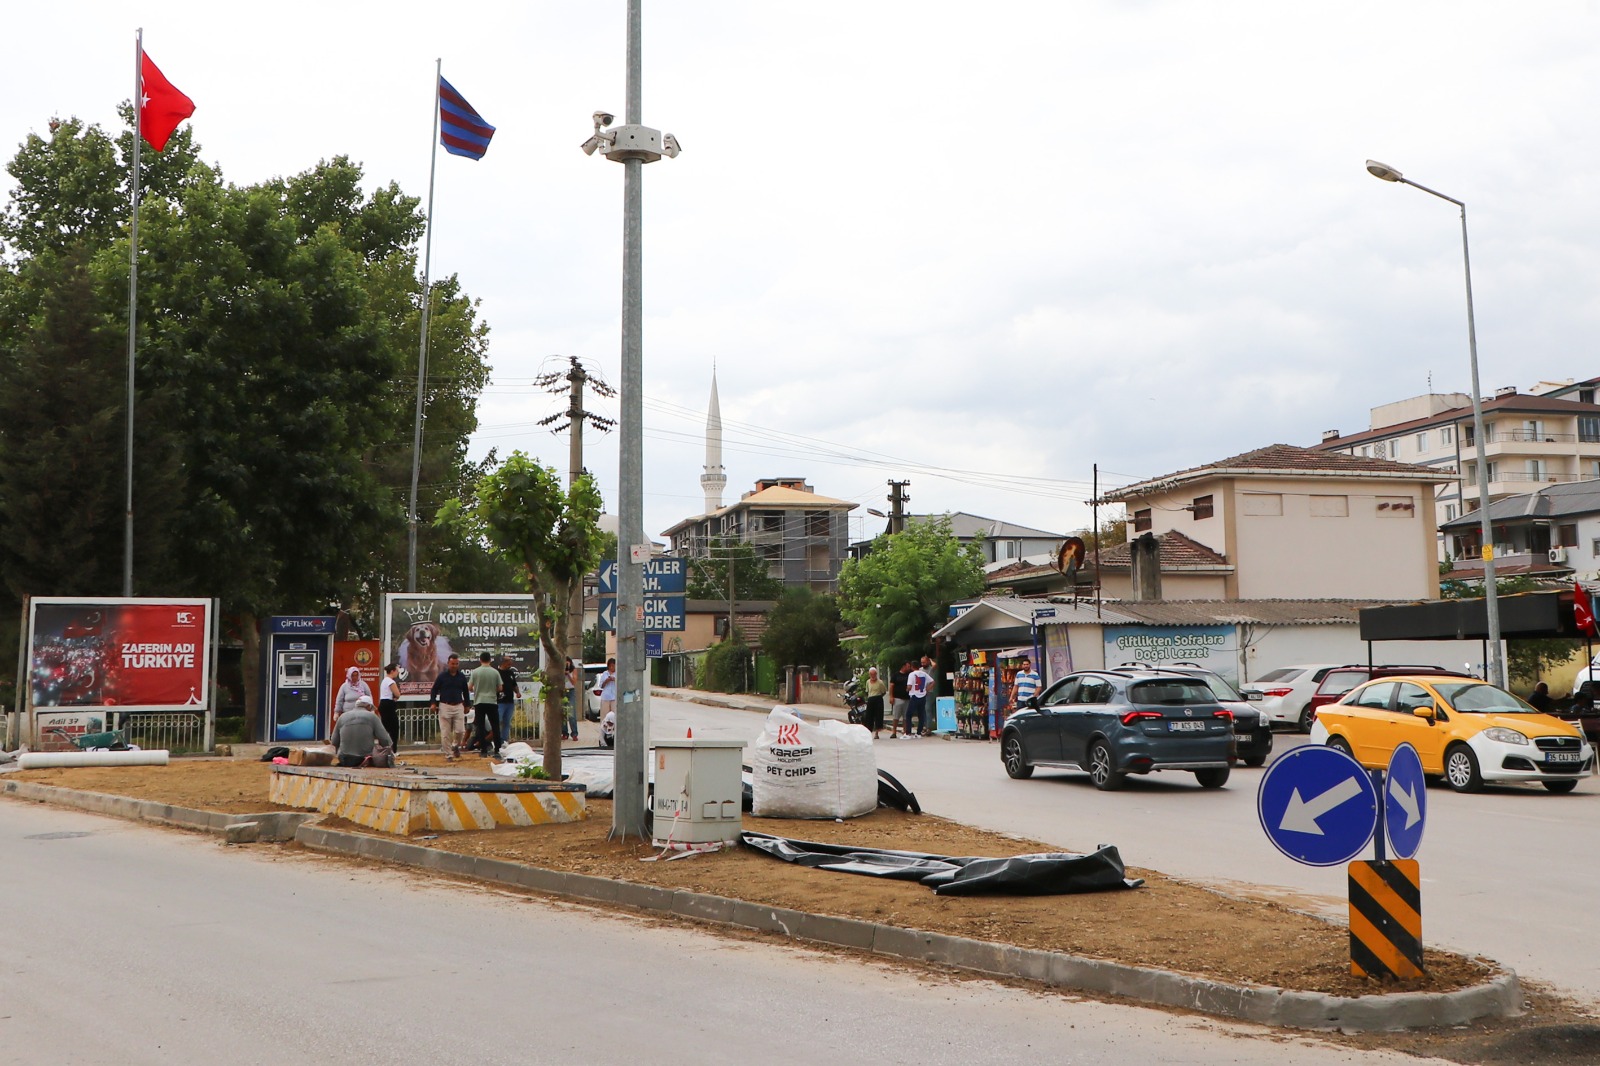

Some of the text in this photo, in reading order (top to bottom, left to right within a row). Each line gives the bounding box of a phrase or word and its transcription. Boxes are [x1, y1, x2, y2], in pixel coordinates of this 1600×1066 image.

[439, 610, 536, 624] KÖPEK GÜZELLİK
[457, 626, 518, 640] YARIŞMASI
[121, 643, 195, 653] ZAFERİN ADI
[1117, 634, 1225, 650] Çiftlikten Sofralara
[121, 654, 195, 668] TÜRKİYE
[1135, 647, 1209, 662] Doğal Lezzet
[766, 765, 817, 778] PET CHIPS
